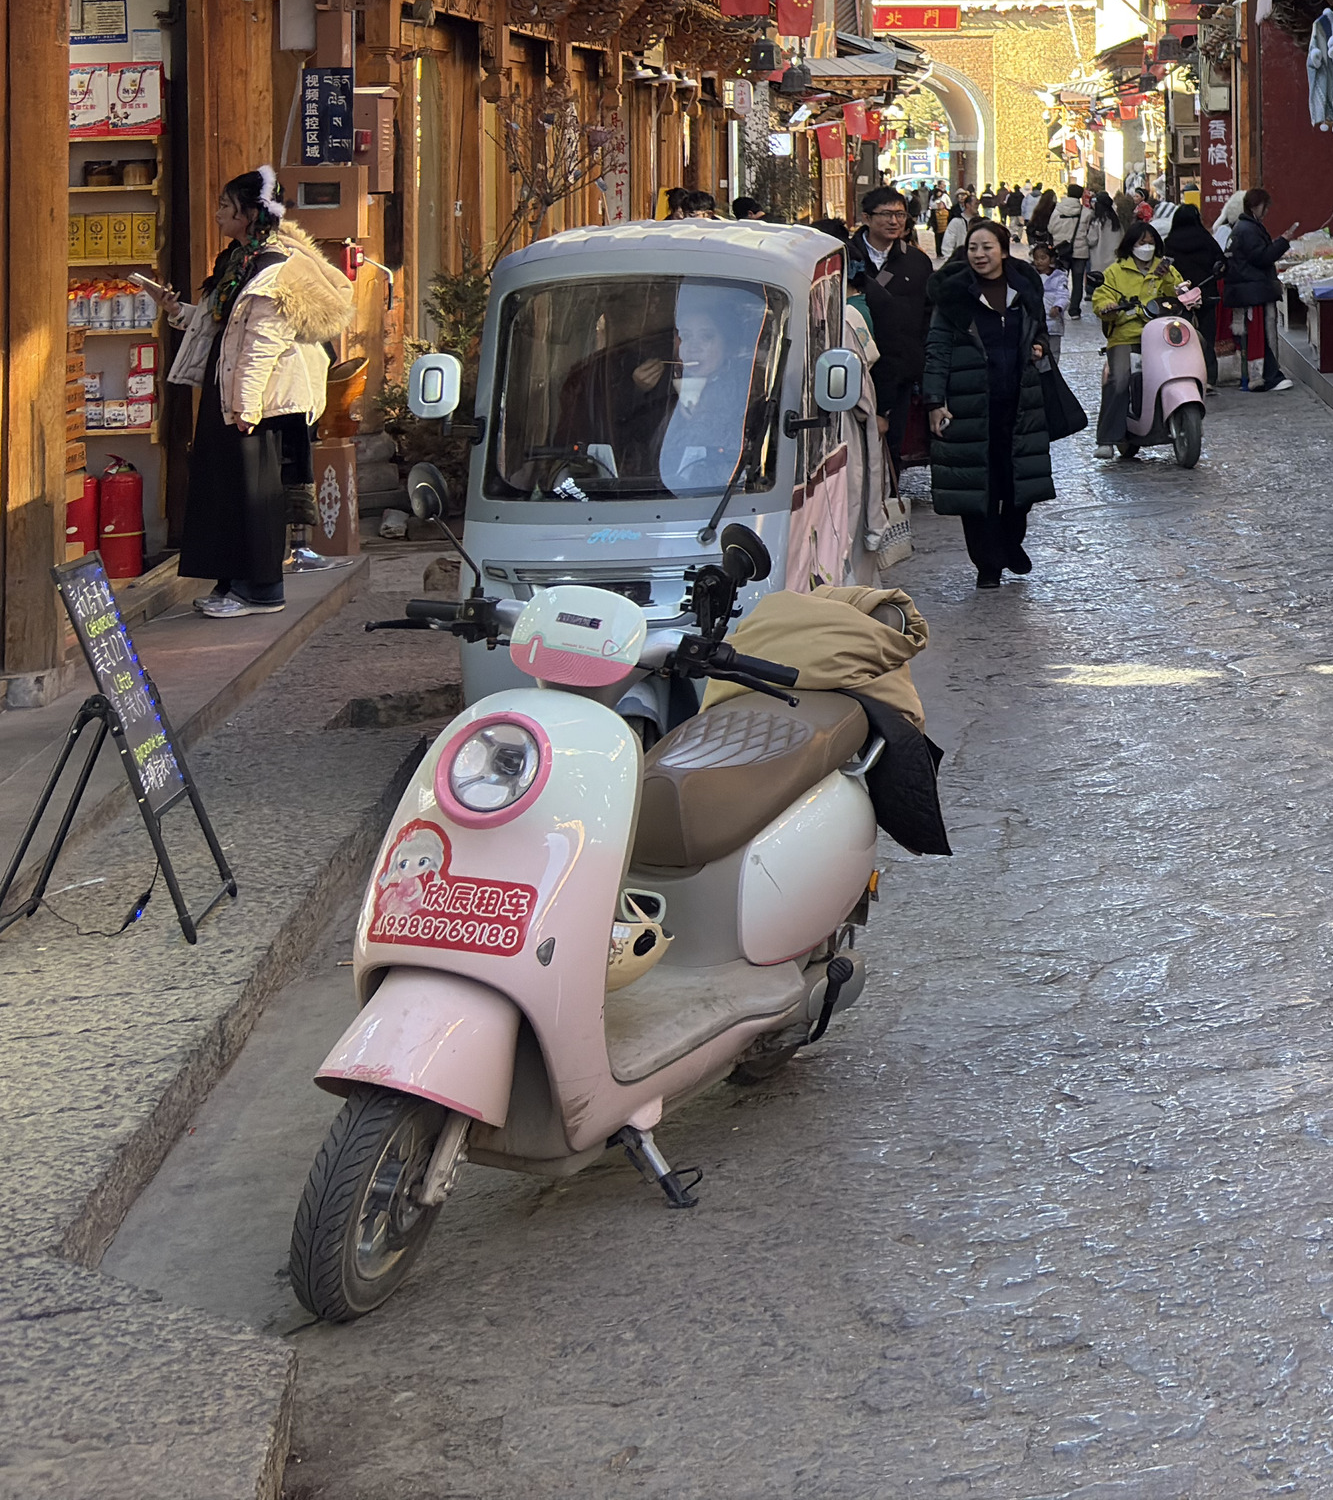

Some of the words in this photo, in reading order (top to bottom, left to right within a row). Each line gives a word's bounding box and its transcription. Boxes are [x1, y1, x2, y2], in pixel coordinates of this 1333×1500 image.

[885, 9, 939, 28] 北門
[305, 74, 320, 158] 视频监控区域
[421, 880, 530, 920] 欣辰租车
[376, 913, 519, 949] 19988769188
